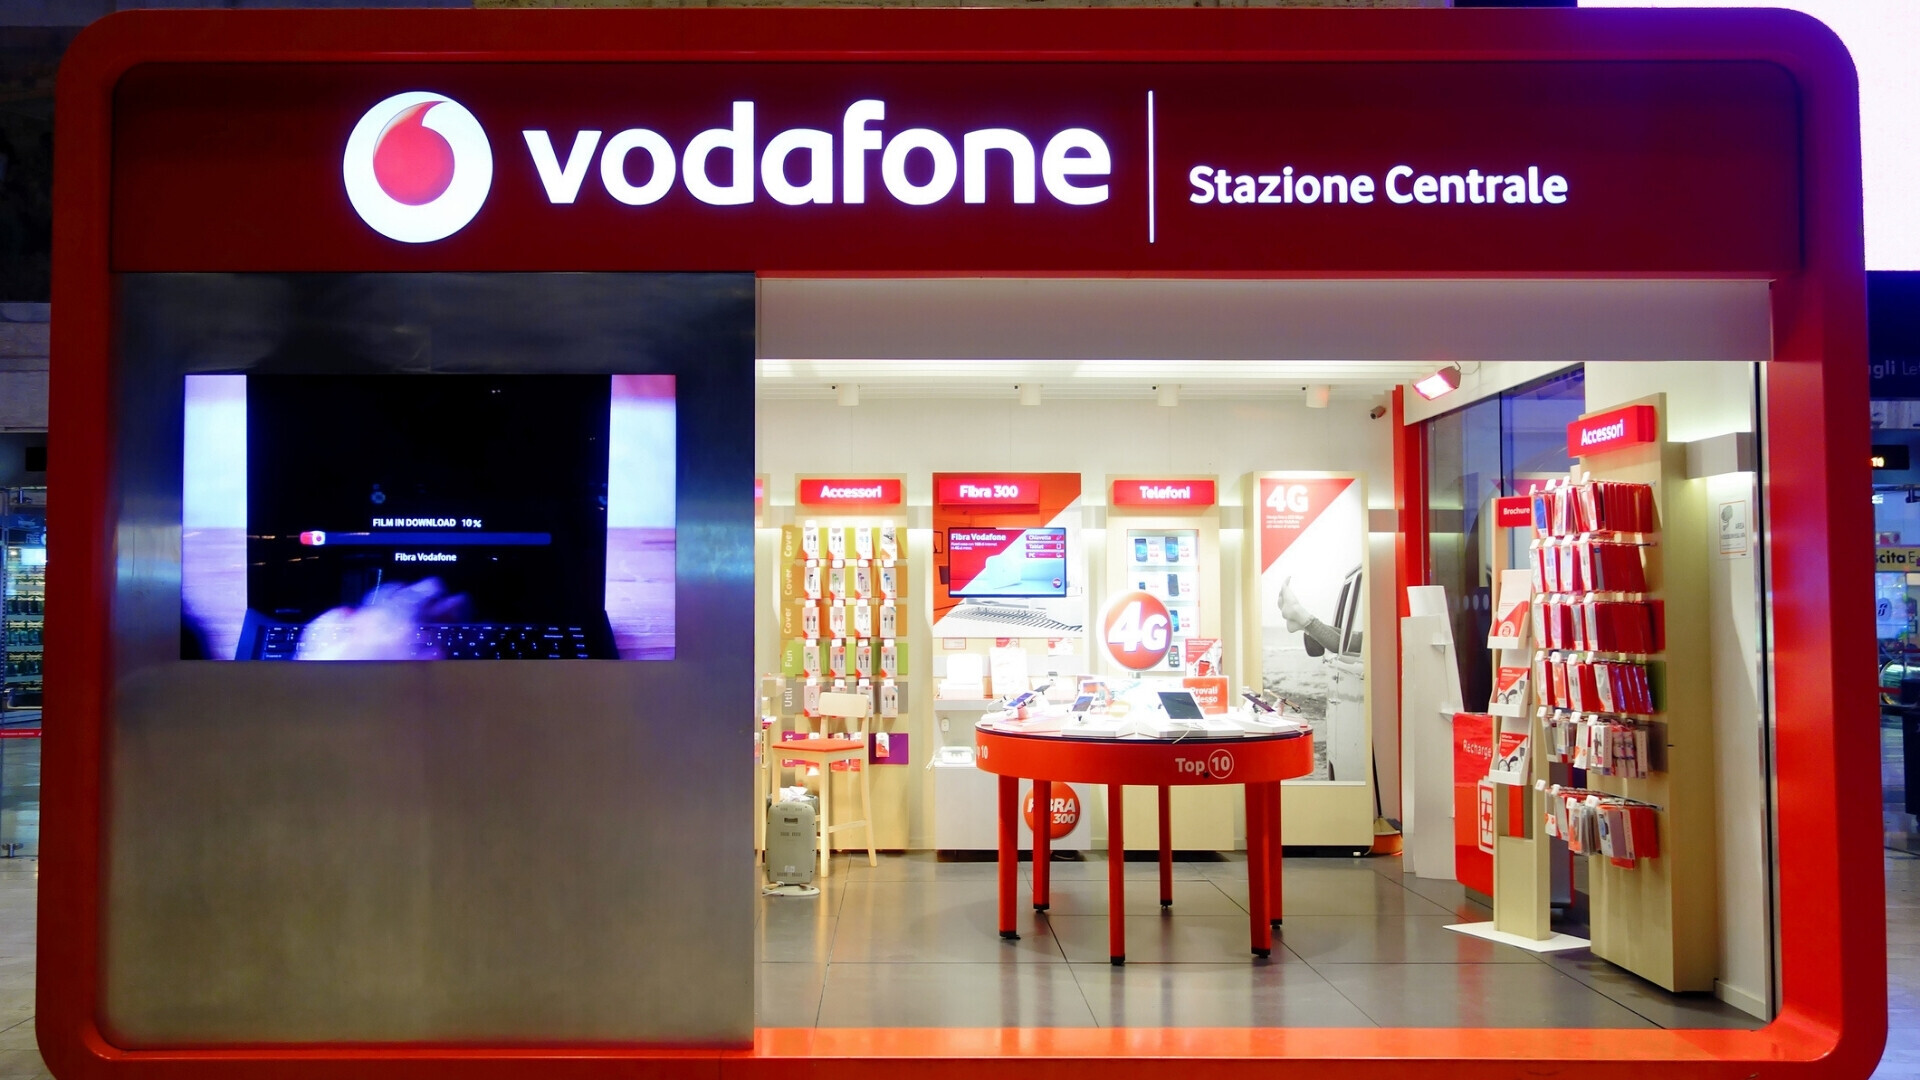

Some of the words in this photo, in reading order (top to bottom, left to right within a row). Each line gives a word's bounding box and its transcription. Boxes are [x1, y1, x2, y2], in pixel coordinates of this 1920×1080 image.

[522, 99, 1112, 206] vodafone
[1189, 165, 1375, 205] Stazione
[1385, 165, 1569, 205] Centrale
[1868, 359, 1896, 379] gli
[1902, 360, 1920, 376] Le
[1580, 419, 1624, 446] Accessori
[820, 485, 882, 499] Accessori
[959, 485, 993, 499] Fibra
[994, 485, 1018, 499] 300
[1139, 486, 1191, 500] Telefoni
[1266, 484, 1309, 513] 4G
[1502, 506, 1531, 516] Brochure
[373, 518, 394, 528] FILM
[394, 518, 405, 528] IN
[405, 518, 457, 528] DOWNLOAD
[784, 530, 793, 557] Cover
[950, 533, 971, 541] Fibra
[971, 533, 1007, 541] Vodafone
[395, 552, 417, 561] Fibra
[417, 552, 457, 561] Vodafone
[784, 568, 793, 596] Cover
[784, 607, 792, 634] Cover
[1108, 602, 1167, 652] 4G
[784, 649, 793, 668] Fun
[784, 687, 793, 708] Utili
[1175, 757, 1205, 775] Top
[1211, 756, 1231, 772] 10
[1052, 813, 1076, 824] 300
